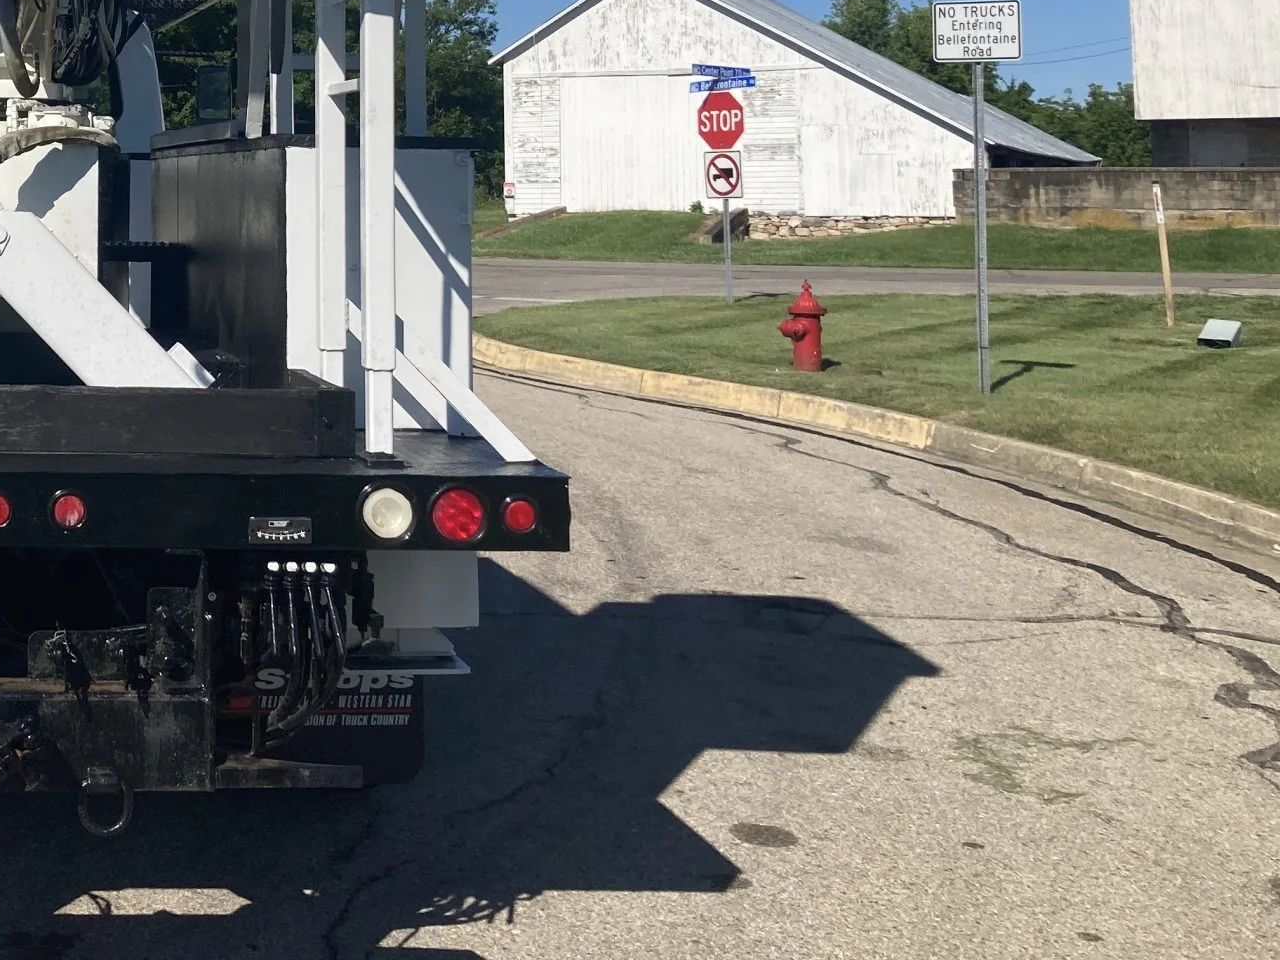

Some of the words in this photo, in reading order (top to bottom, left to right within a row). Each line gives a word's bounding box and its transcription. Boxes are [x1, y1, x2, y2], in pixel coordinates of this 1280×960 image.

[938, 6, 956, 19] NO
[962, 4, 1015, 18] TRUCKS
[951, 19, 1002, 33] Entering
[937, 33, 1017, 46] Bellefontaine
[963, 46, 992, 57] Road
[701, 65, 719, 76] Center
[719, 67, 734, 78] Point
[700, 109, 742, 132] STOP
[254, 668, 415, 693] Sops
[338, 695, 384, 709] WESTERN
[387, 694, 413, 708] STAR
[326, 714, 338, 726] OF
[341, 713, 368, 727] TRUCK
[370, 713, 411, 727] COUNTRY
